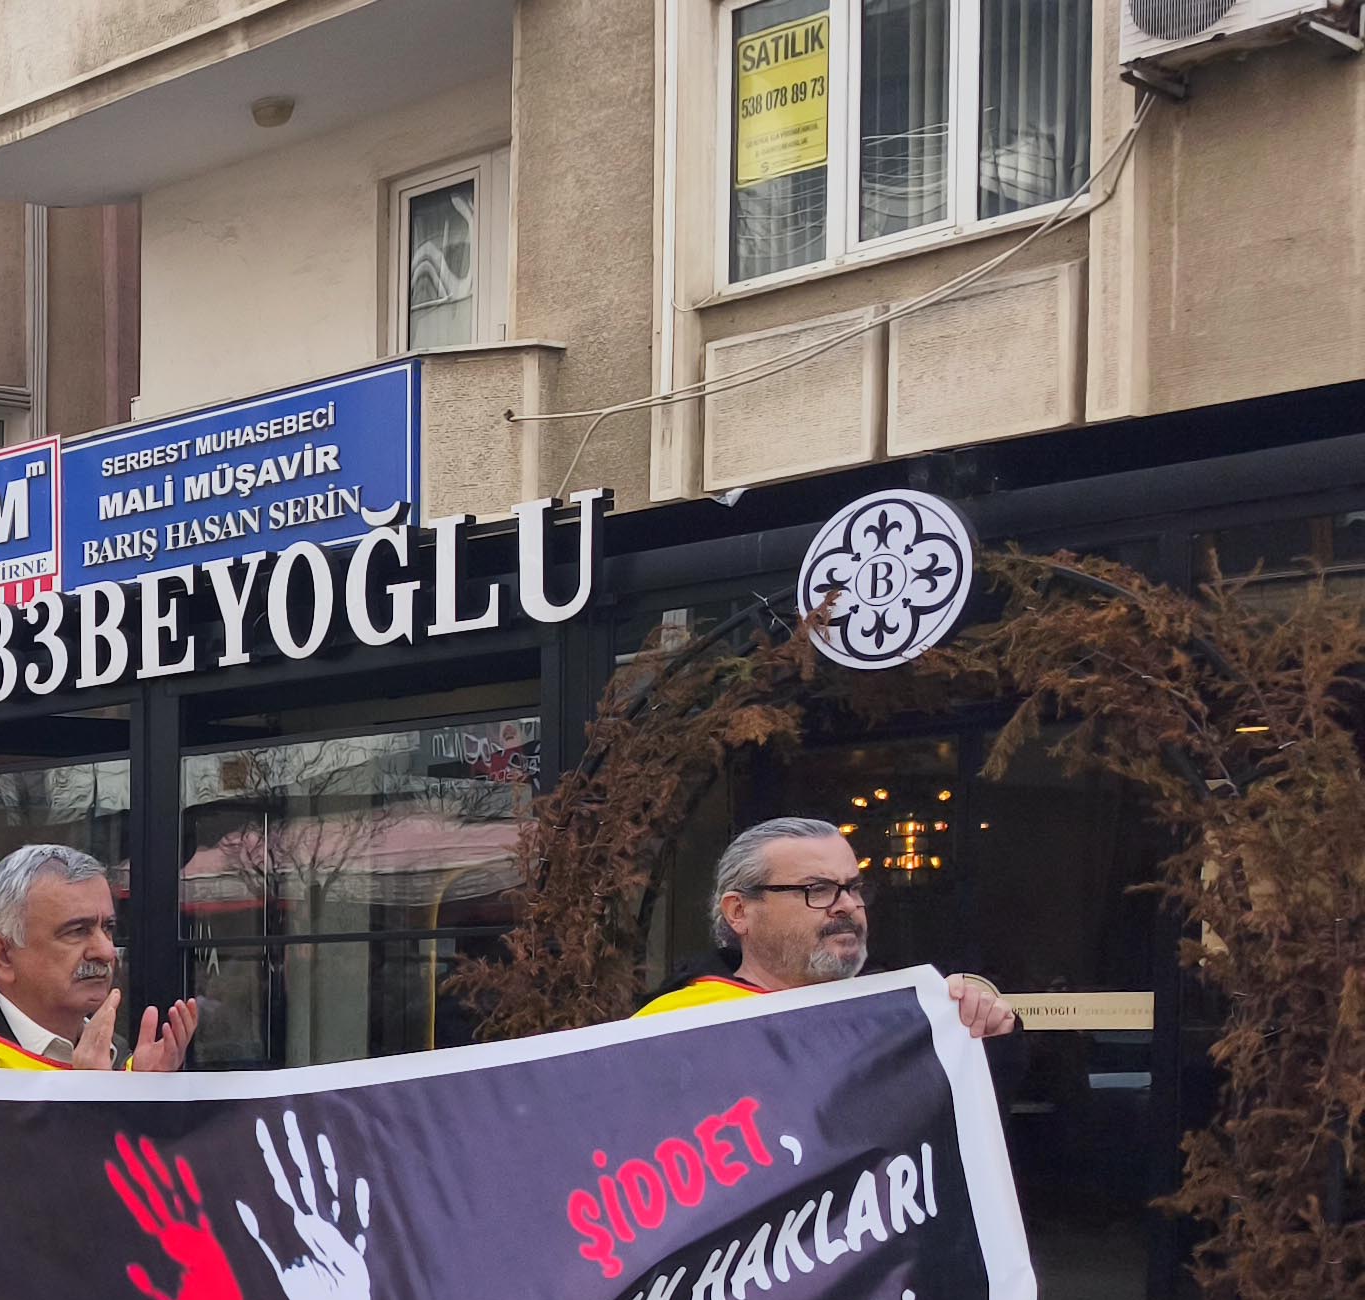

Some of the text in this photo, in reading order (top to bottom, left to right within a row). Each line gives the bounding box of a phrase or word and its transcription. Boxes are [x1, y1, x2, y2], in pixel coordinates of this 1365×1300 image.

[742, 22, 824, 72] SATILIK
[741, 76, 825, 119] 538 078 89 73
[101, 401, 336, 477] SERBEST MUHASEBECİ
[99, 443, 341, 521] MALİ MÜŞAVİR
[82, 484, 363, 567] BARIŞ HASAN SERİN
